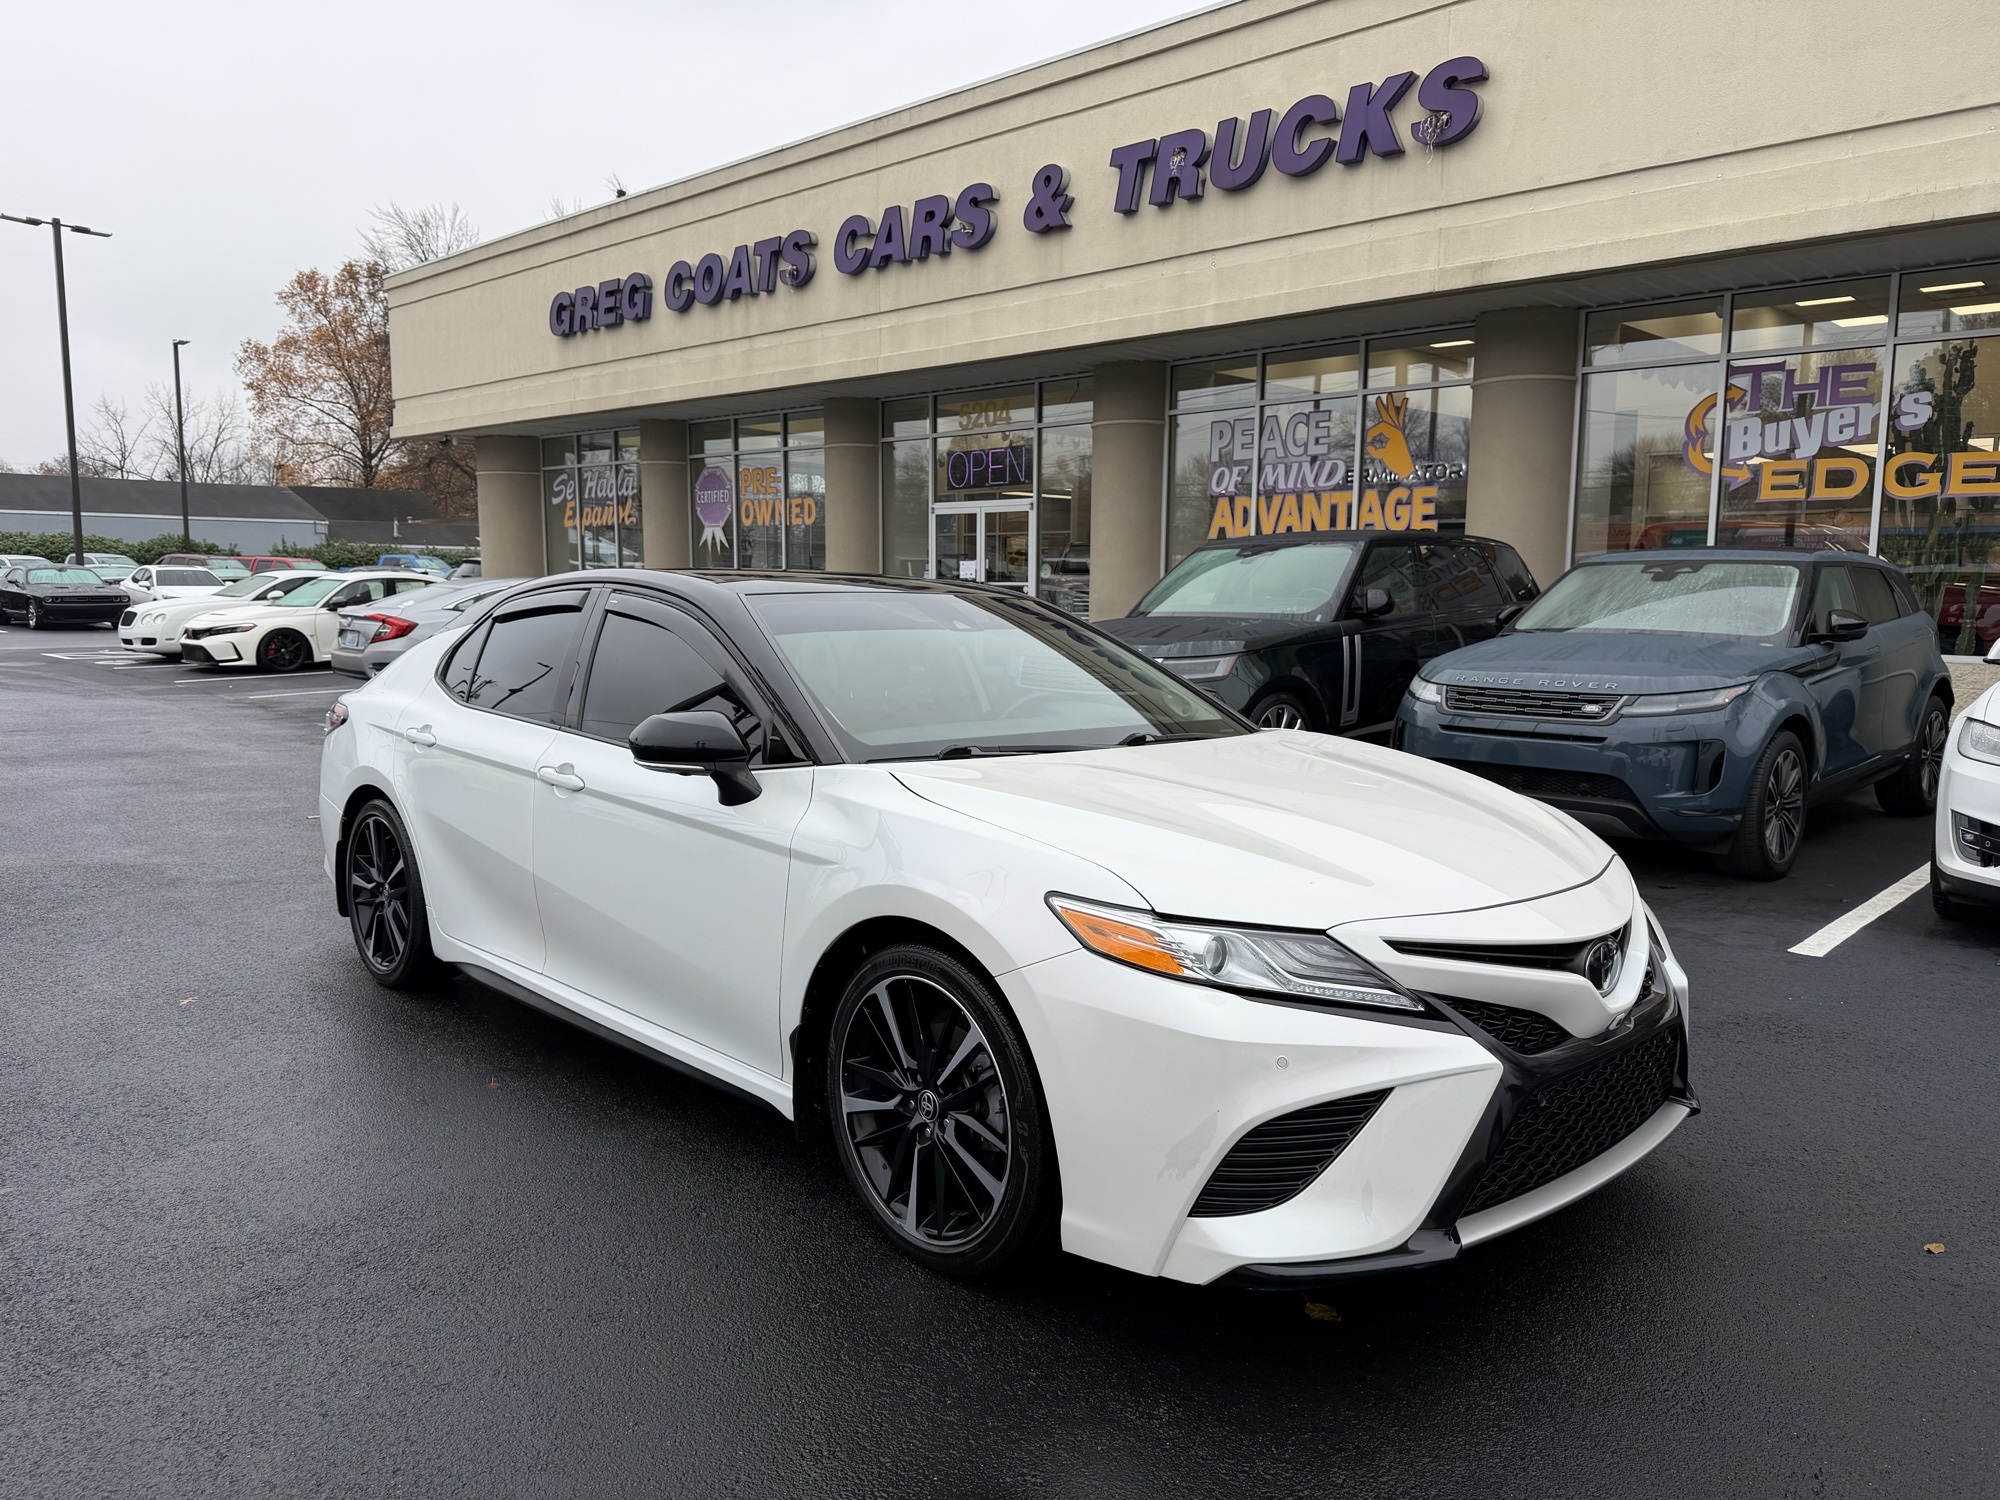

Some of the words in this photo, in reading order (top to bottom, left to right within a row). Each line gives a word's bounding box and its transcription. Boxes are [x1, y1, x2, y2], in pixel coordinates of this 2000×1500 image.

[550, 272, 653, 337] GREG
[665, 229, 818, 312] COATS
[833, 182, 1000, 275] CARS
[1023, 164, 1075, 235] &
[1109, 55, 1490, 215] TRUCKS
[1729, 359, 1877, 414] THE
[958, 400, 1012, 430] 5204
[1210, 409, 1332, 462] PEACE
[741, 467, 782, 495] PRE-
[948, 447, 1026, 488] OPEN
[1208, 465, 1249, 496] OF
[1258, 459, 1347, 494] MIND
[1755, 452, 2000, 502] EDGE
[552, 473, 575, 505] Se
[583, 468, 637, 499] Habla
[696, 490, 730, 504] CERTIFIED
[564, 498, 637, 536] Epañl
[741, 497, 816, 527] OWNED
[1207, 486, 1439, 540] ADVANTAGE
[1455, 674, 1524, 685] RANGE
[1538, 679, 1619, 690] ROVER
